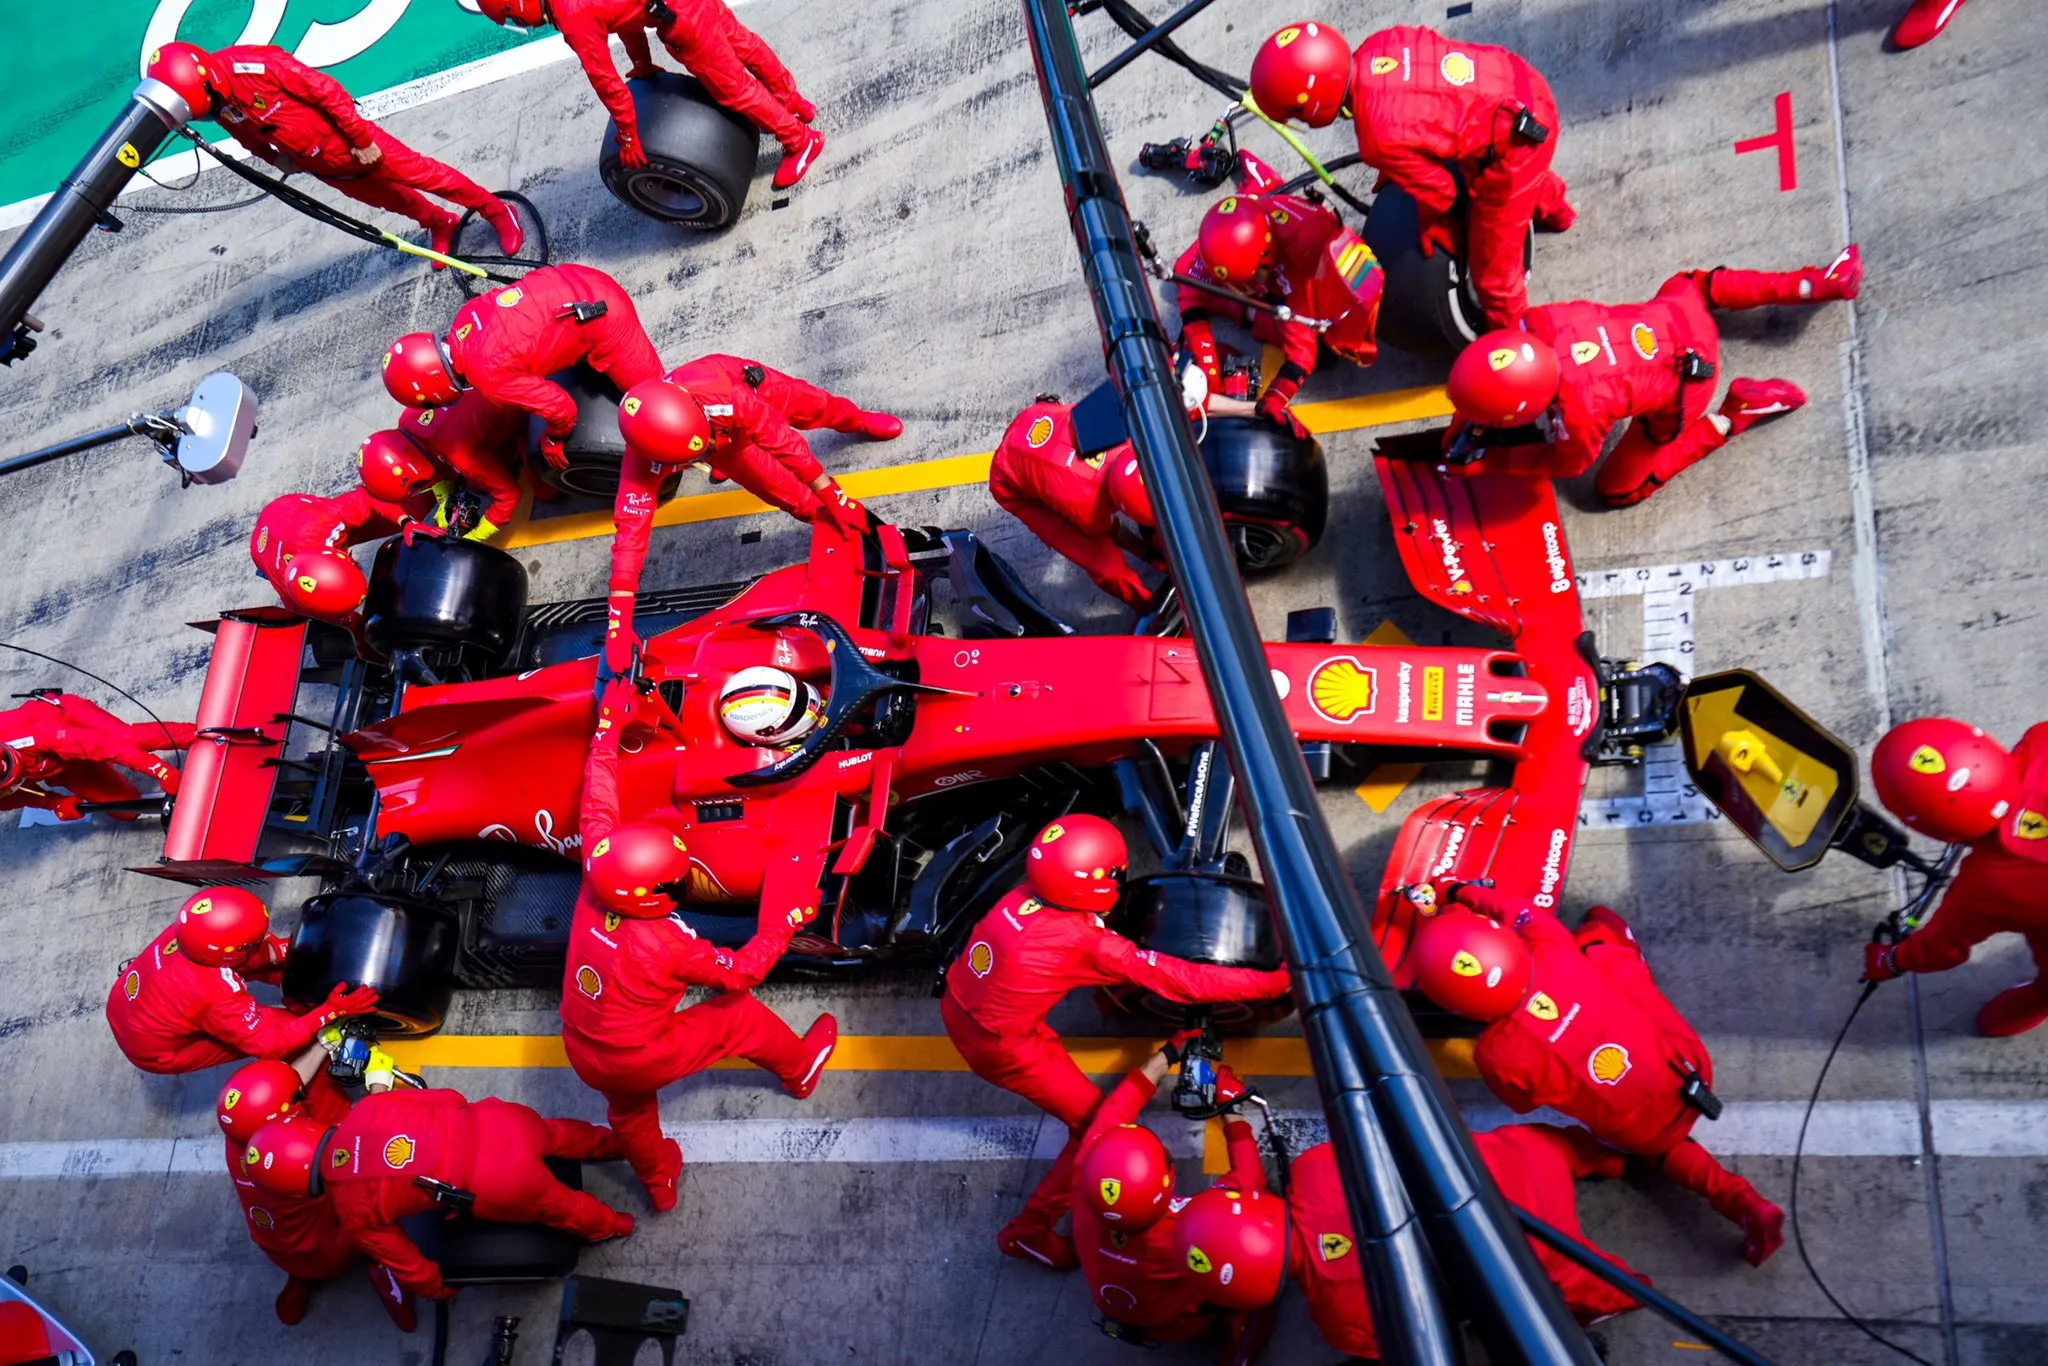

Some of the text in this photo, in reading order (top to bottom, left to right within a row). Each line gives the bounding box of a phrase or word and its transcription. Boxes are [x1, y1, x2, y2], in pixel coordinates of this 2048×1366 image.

[1433, 519, 1465, 582] V-Power
[1637, 569, 1651, 581] 0
[1668, 568, 1682, 578] 1
[1700, 564, 1716, 575] 2
[1733, 560, 1749, 572] 3
[1679, 583, 1694, 595] 2
[1679, 612, 1690, 624] 1
[858, 647, 886, 657] HUBL
[1679, 641, 1695, 653] 0
[1395, 661, 1413, 723] kaspersky
[1456, 663, 1475, 726] MAHLE
[729, 706, 774, 722] kaspersky
[838, 752, 874, 769] HUBLOT
[1186, 751, 1210, 837] #WeRaceAsOne
[1638, 810, 1654, 823] 0
[1672, 809, 1688, 820] 1
[1706, 807, 1722, 820] 2
